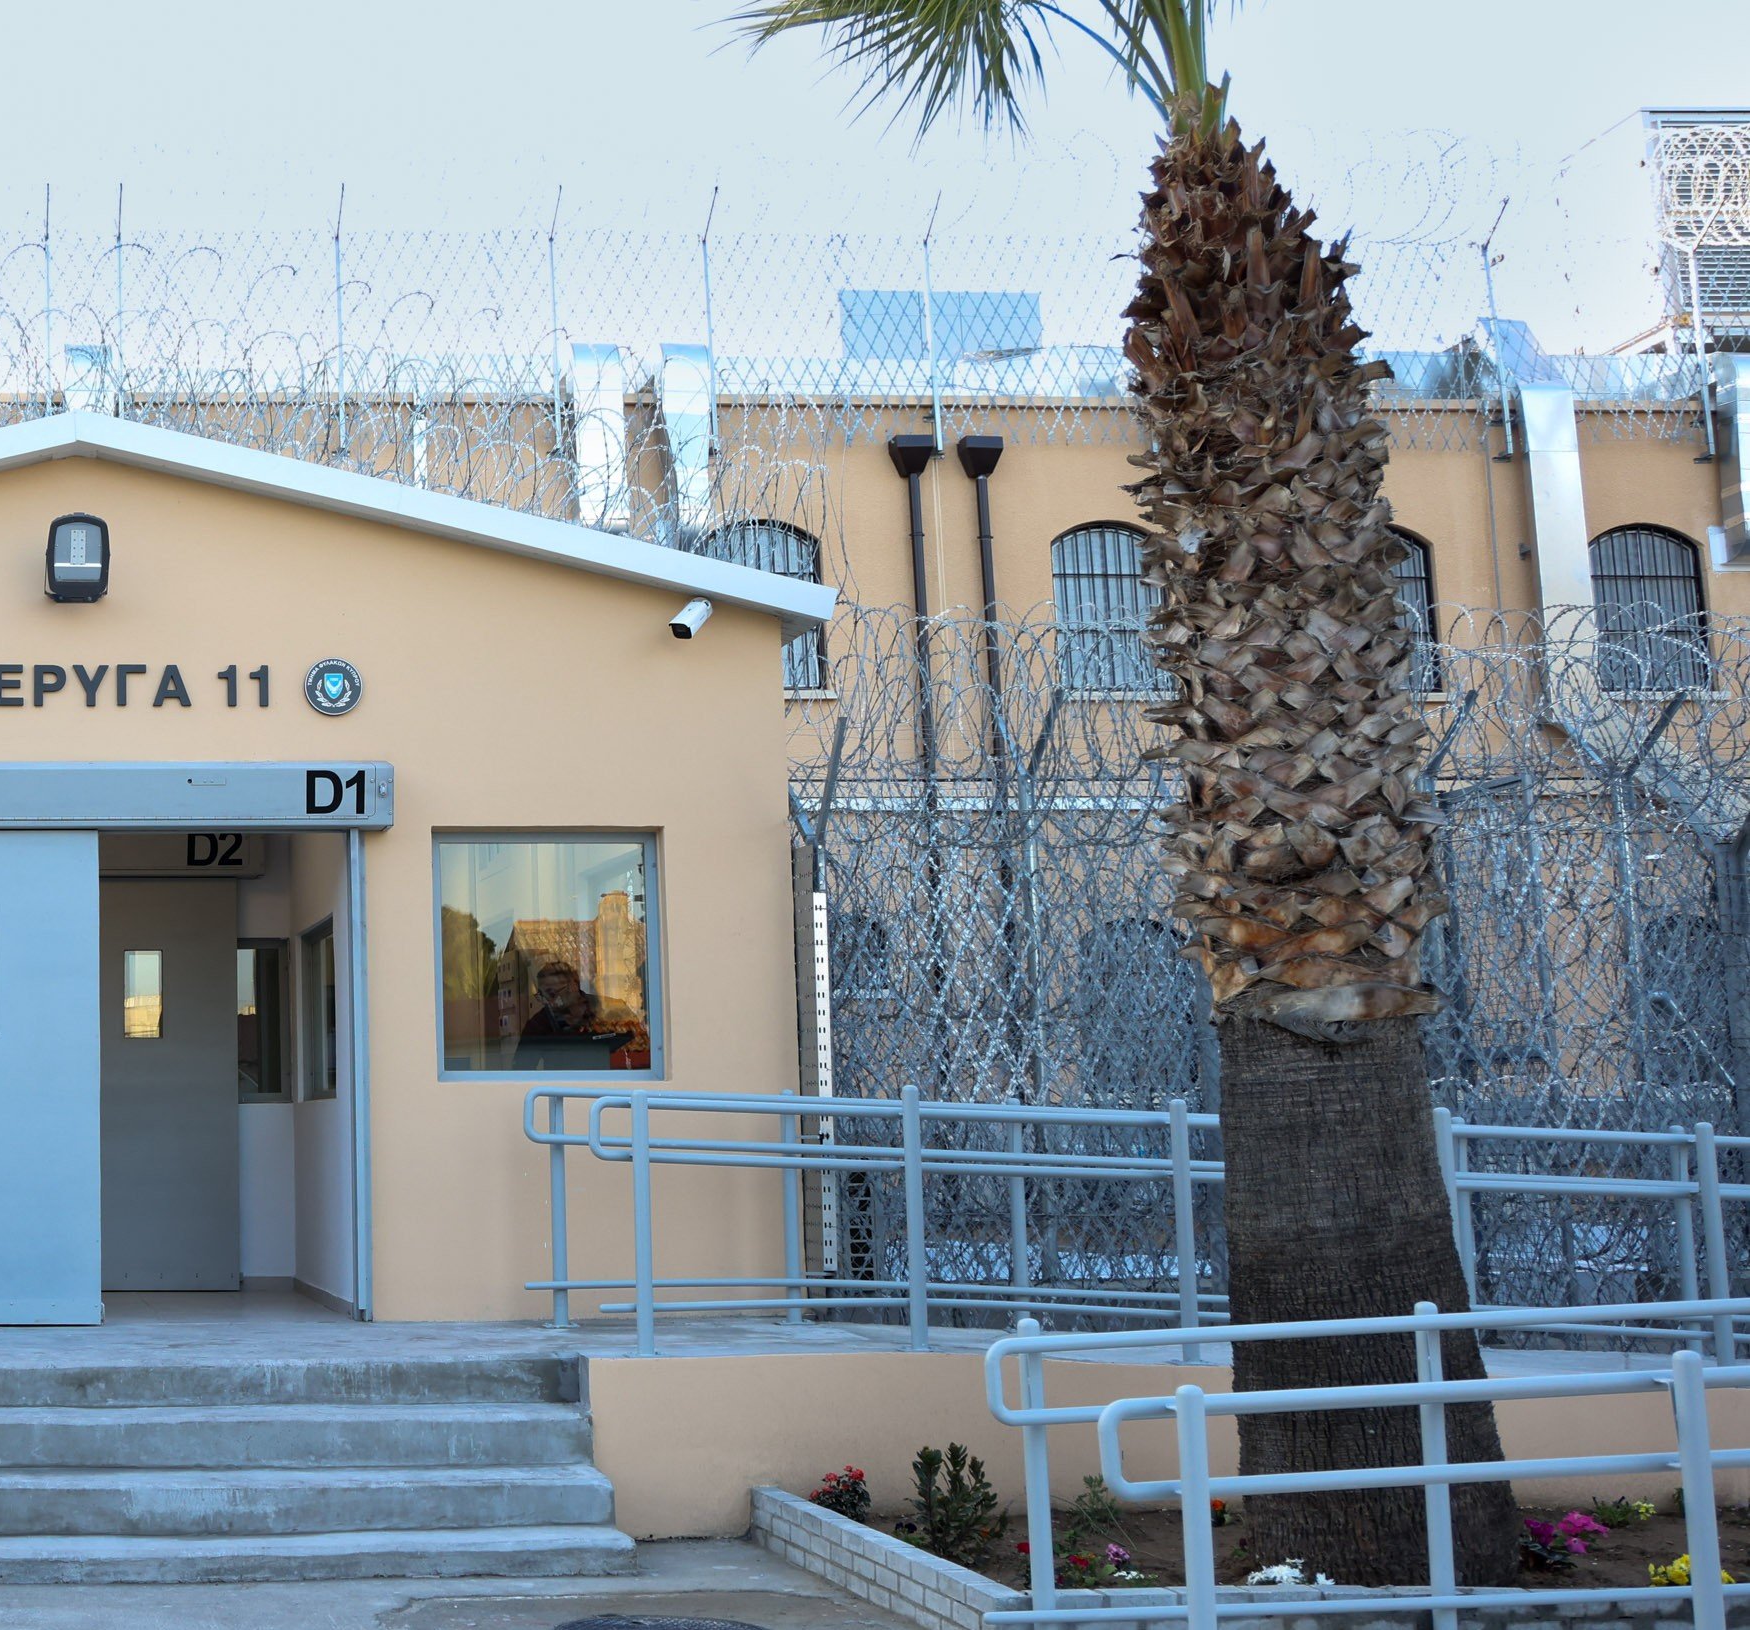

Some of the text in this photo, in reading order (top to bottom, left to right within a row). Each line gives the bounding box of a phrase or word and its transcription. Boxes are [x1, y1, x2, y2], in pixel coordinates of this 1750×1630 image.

[217, 664, 269, 708] 11
[307, 659, 361, 687] ΤΜΗΜΑ ΦΥΛΑΚΩΝ ΚΥΠΡΟΥ
[306, 770, 366, 815] D1
[186, 833, 243, 866] D2
